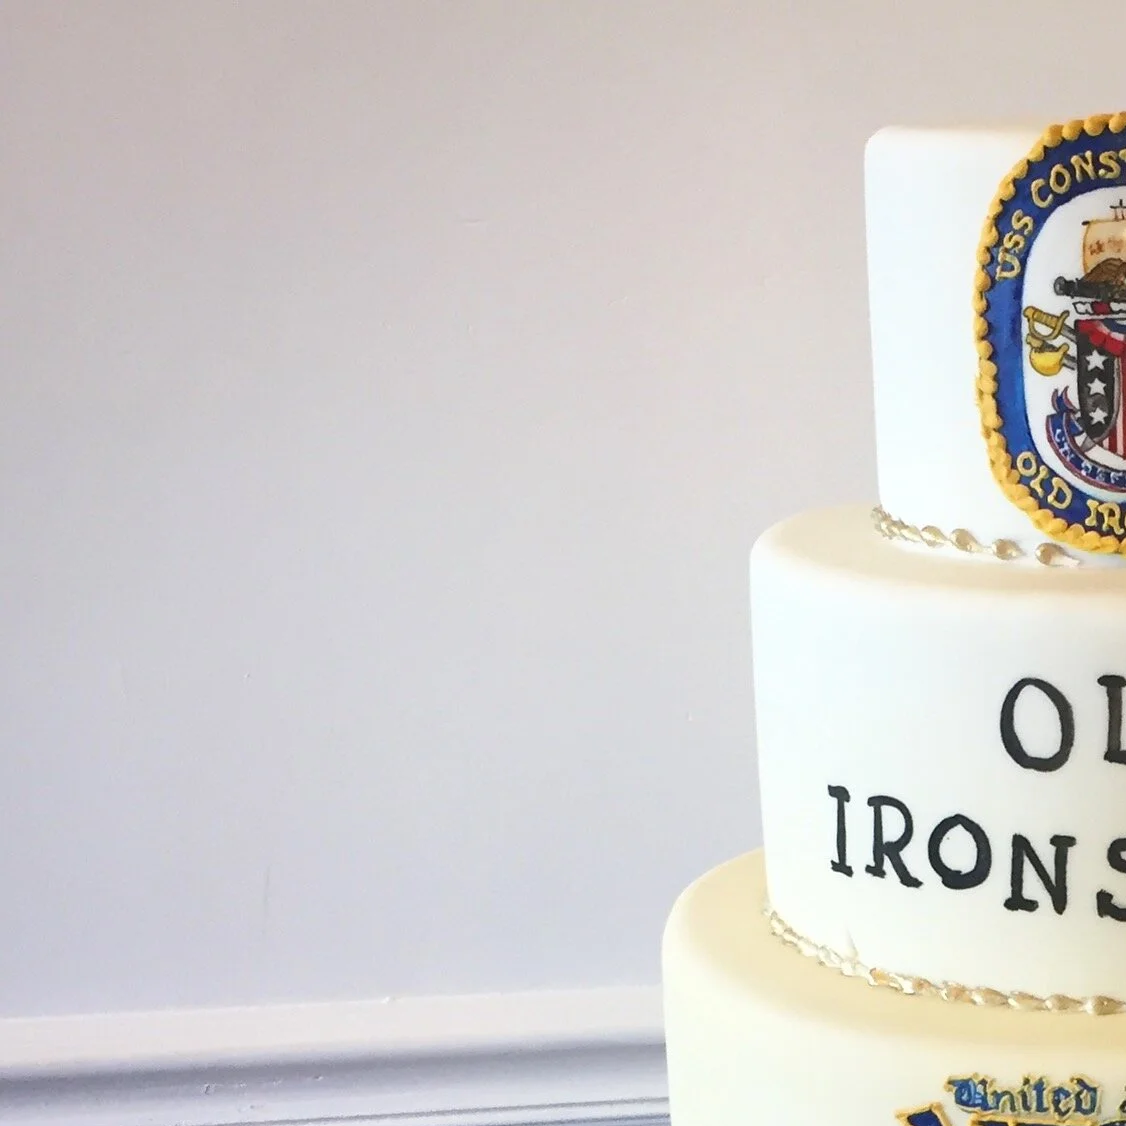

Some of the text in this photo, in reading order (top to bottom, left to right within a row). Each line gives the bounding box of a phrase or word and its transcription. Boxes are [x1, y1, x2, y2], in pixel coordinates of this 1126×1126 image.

[995, 208, 1034, 281] USS
[1015, 451, 1073, 520] OLD
[944, 1072, 1101, 1120] United
